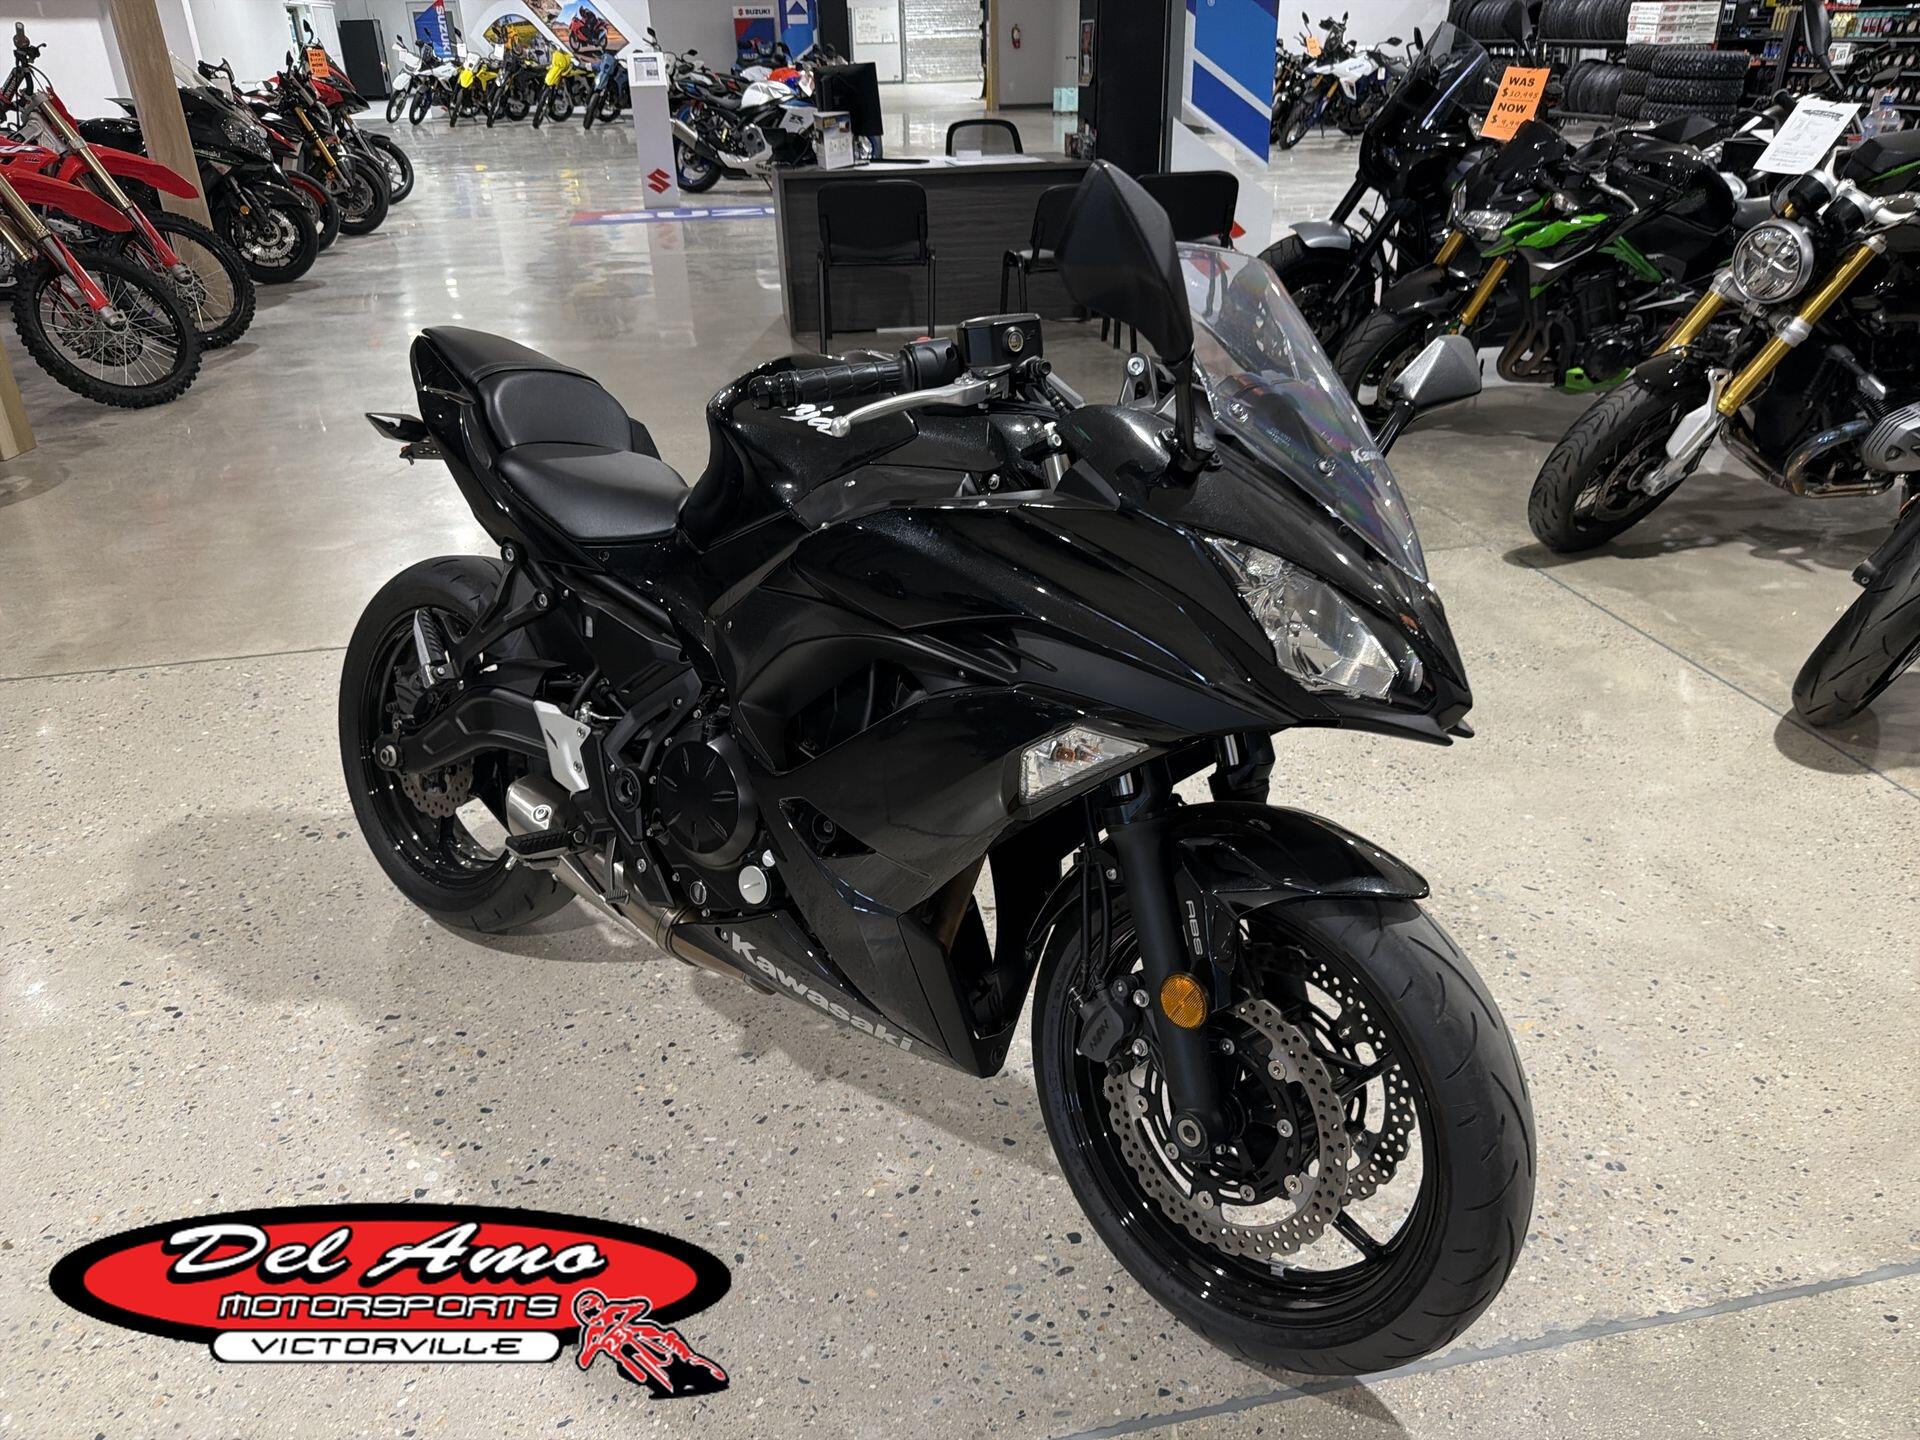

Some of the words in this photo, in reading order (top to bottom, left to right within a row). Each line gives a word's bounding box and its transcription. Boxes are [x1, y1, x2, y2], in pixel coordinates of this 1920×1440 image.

[436, 5, 452, 55] SUZUKI
[1508, 77, 1535, 87] WAS
[1498, 102, 1527, 113] NOW
[1185, 900, 1203, 955] ABS
[731, 931, 913, 1051] Kawasaki
